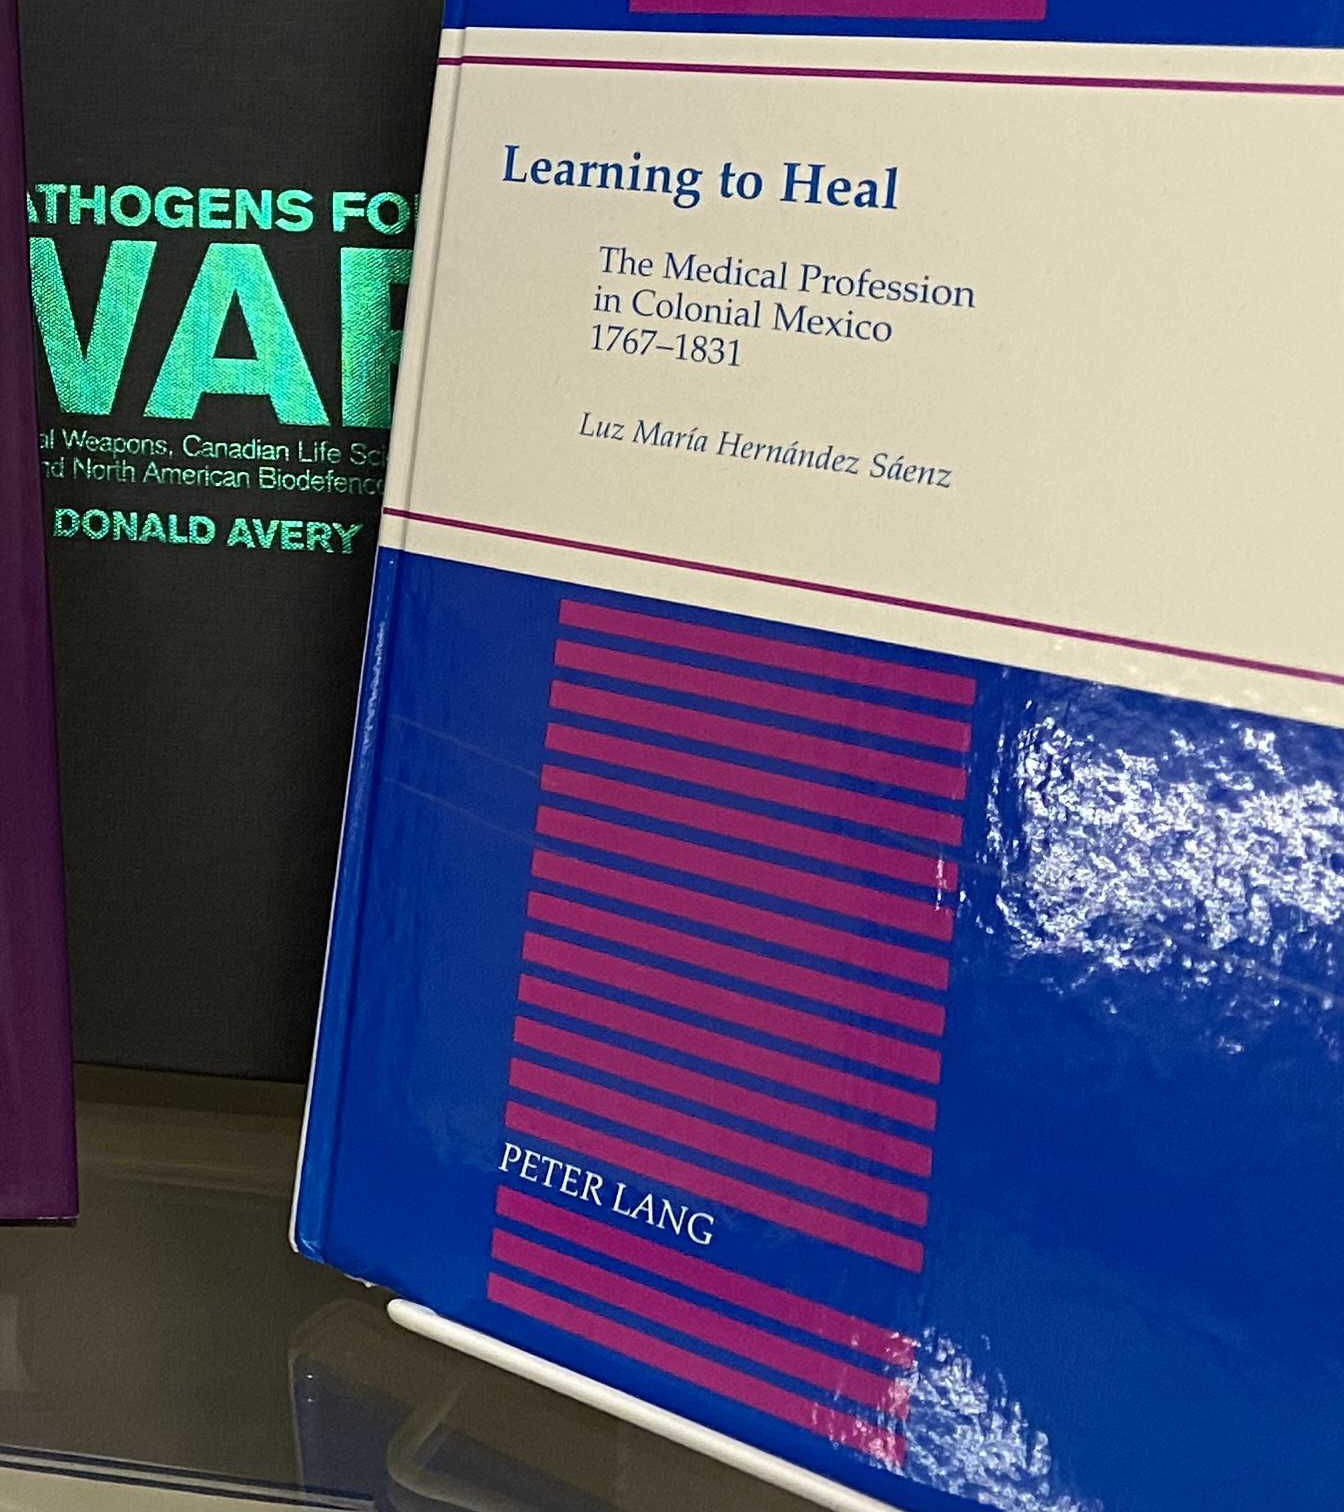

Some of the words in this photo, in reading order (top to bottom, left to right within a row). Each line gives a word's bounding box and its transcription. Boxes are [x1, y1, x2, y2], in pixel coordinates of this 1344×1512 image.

[502, 144, 703, 209] Learning
[720, 161, 763, 200] to
[780, 162, 899, 210] Heal
[332, 191, 420, 236] FO
[598, 245, 653, 277] The
[662, 252, 788, 291] Medical
[799, 264, 976, 309] Profession
[593, 285, 621, 314] in
[632, 288, 762, 329] Colonial
[771, 302, 894, 343] Mexico
[62, 429, 173, 458] Weapons,
[182, 434, 290, 461] Canadian
[298, 440, 341, 464] Life
[73, 457, 135, 482] North
[142, 461, 250, 488] American
[578, 411, 624, 441] Luz
[632, 418, 709, 453] María
[716, 430, 859, 475] Hernández
[869, 452, 953, 489] Sáenz
[52, 507, 216, 546] DONALD
[226, 518, 364, 554] AVERY
[498, 1142, 604, 1207] PETER
[612, 1181, 716, 1247] LANG
